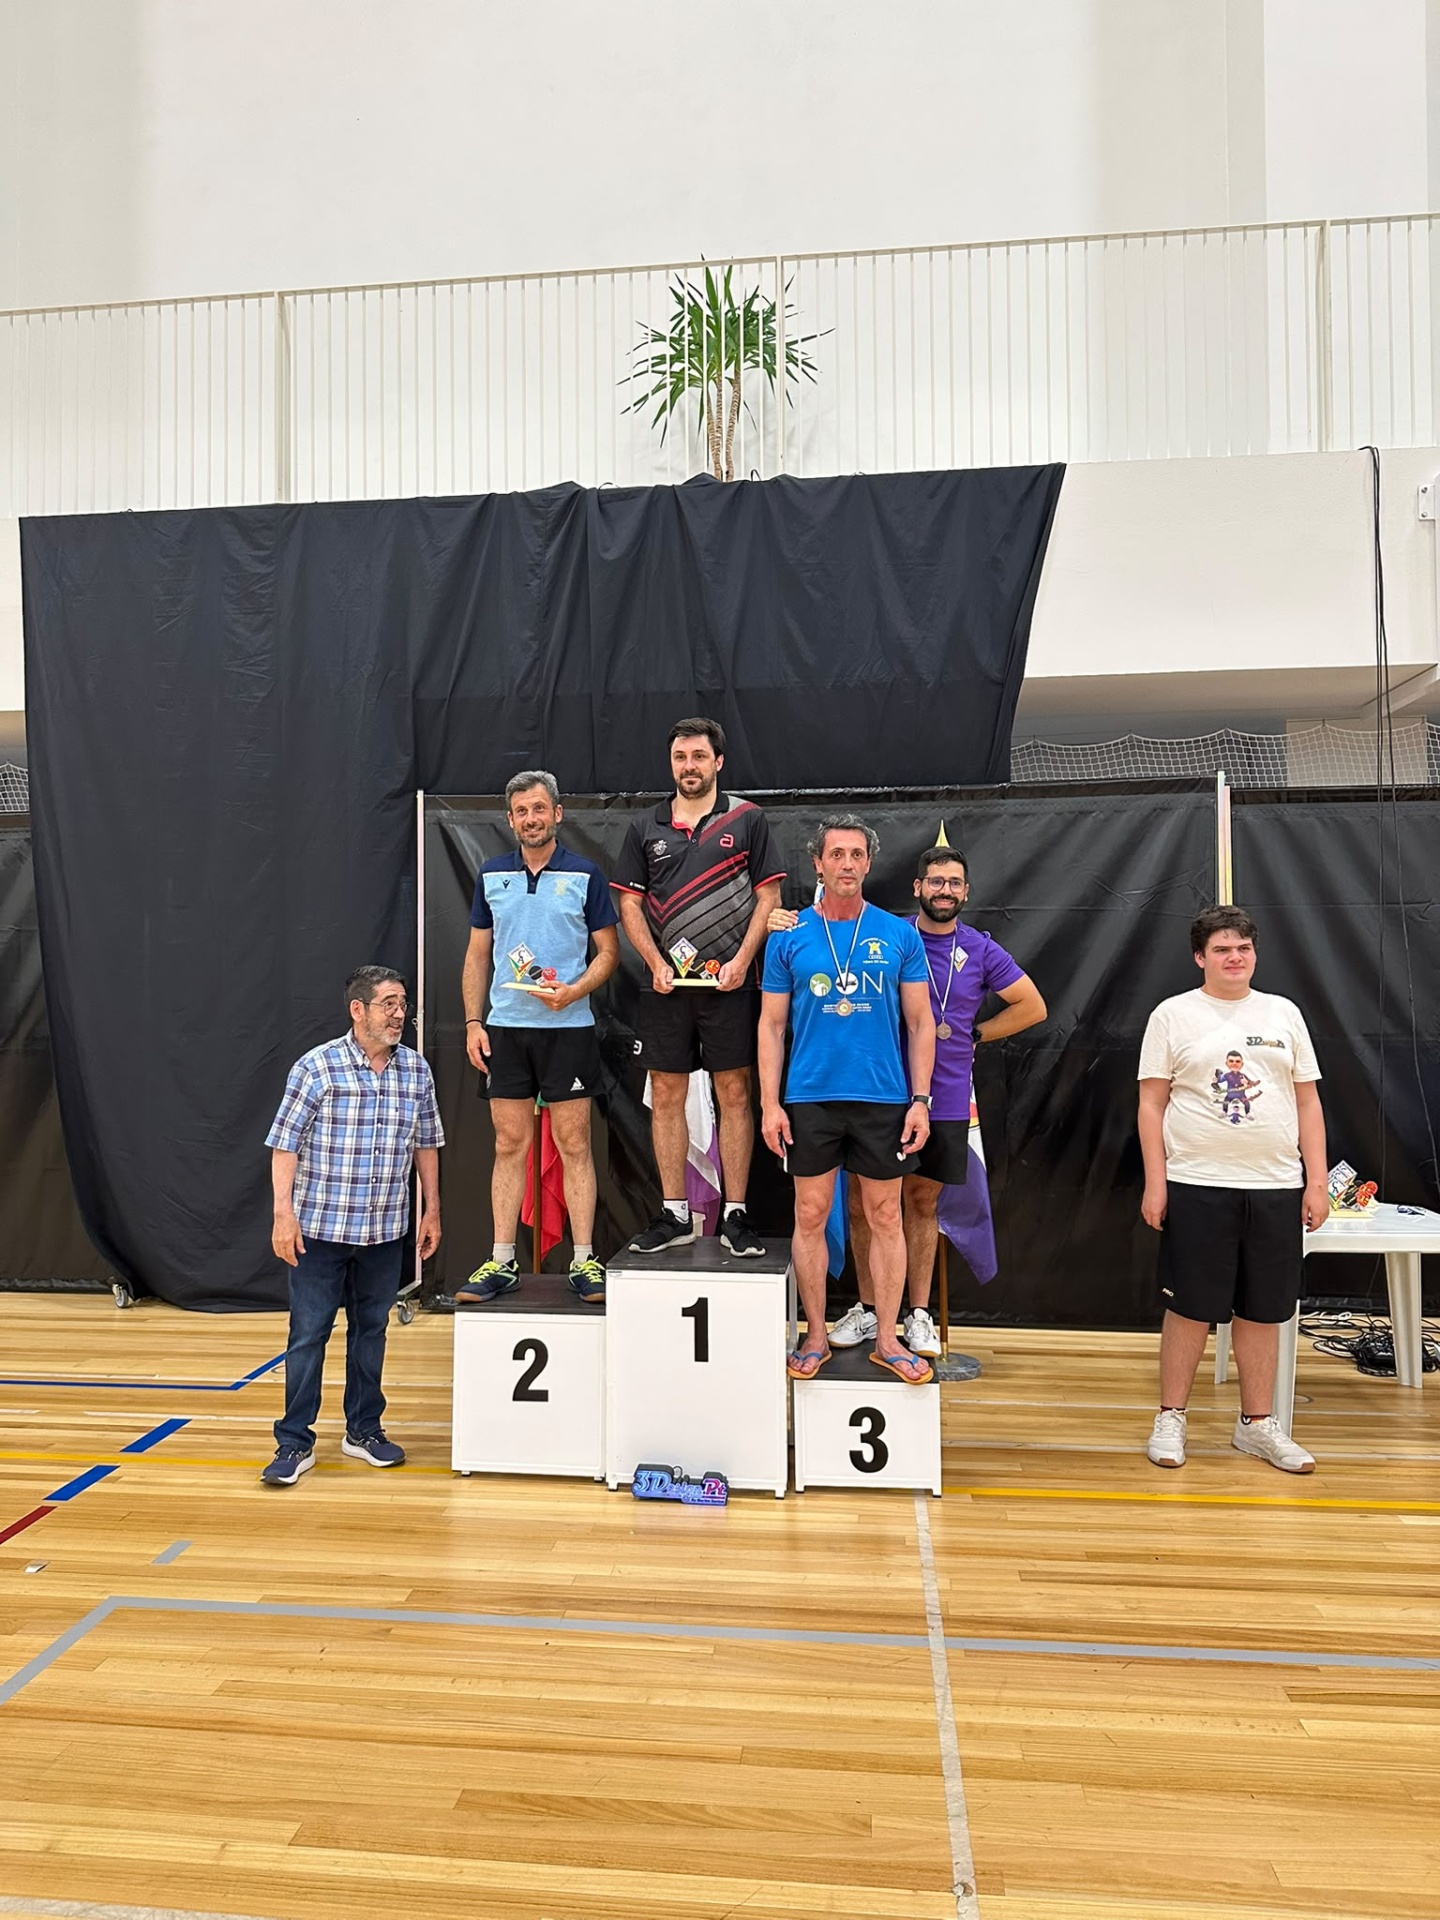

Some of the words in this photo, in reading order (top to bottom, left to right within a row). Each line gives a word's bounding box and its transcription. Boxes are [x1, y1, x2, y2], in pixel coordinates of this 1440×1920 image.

[682, 1297, 709, 1362] 1
[512, 1338, 549, 1402] 2
[849, 1406, 889, 1473] 3
